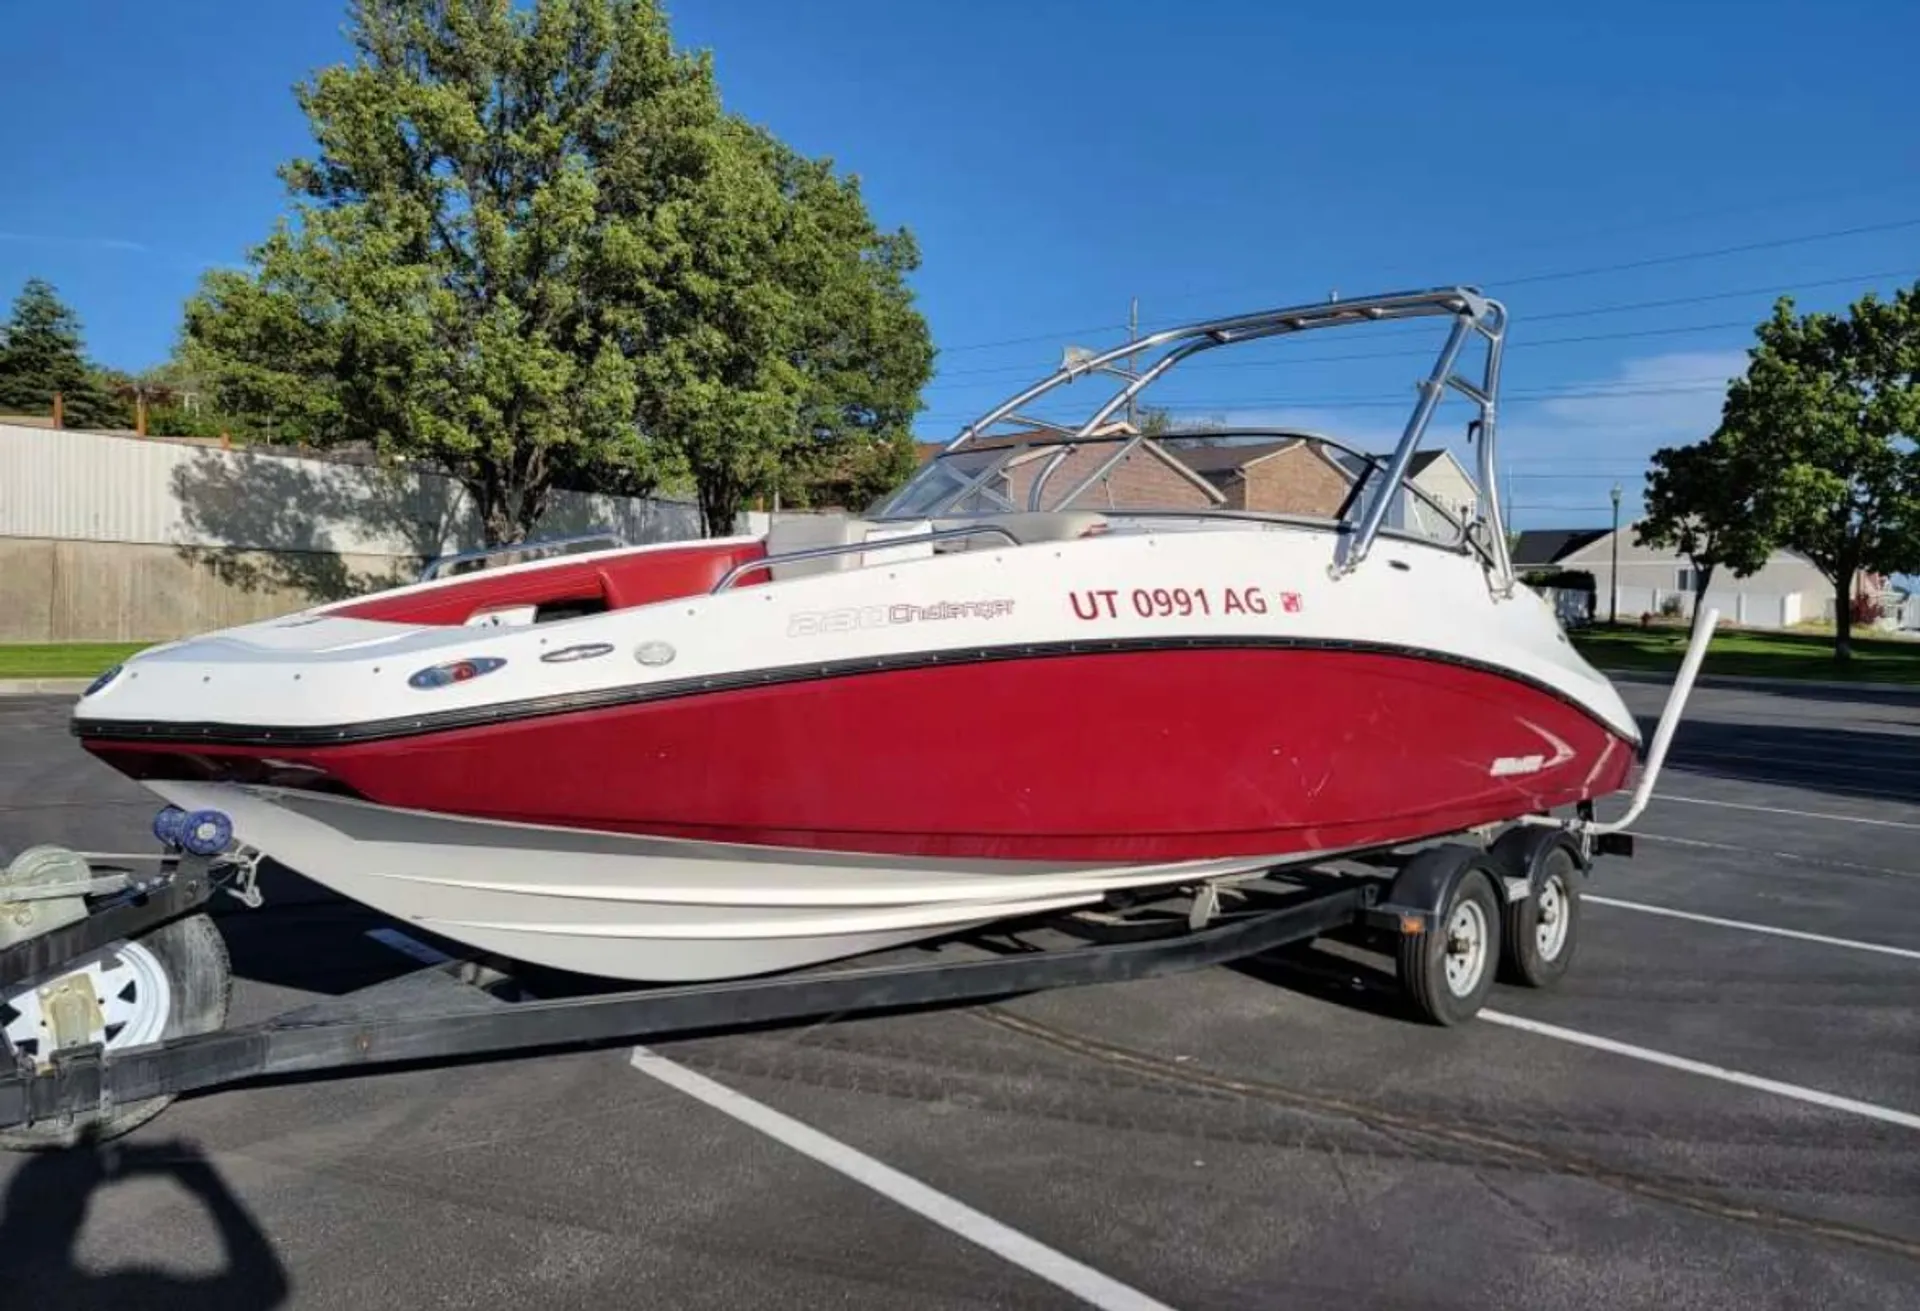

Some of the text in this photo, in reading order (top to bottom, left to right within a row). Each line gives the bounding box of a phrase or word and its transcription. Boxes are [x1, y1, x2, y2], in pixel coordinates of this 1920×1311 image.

[888, 599, 1015, 625] Challenger
[1069, 590, 1118, 620] UT
[1132, 588, 1210, 618] 0991
[1224, 587, 1268, 615] AG
